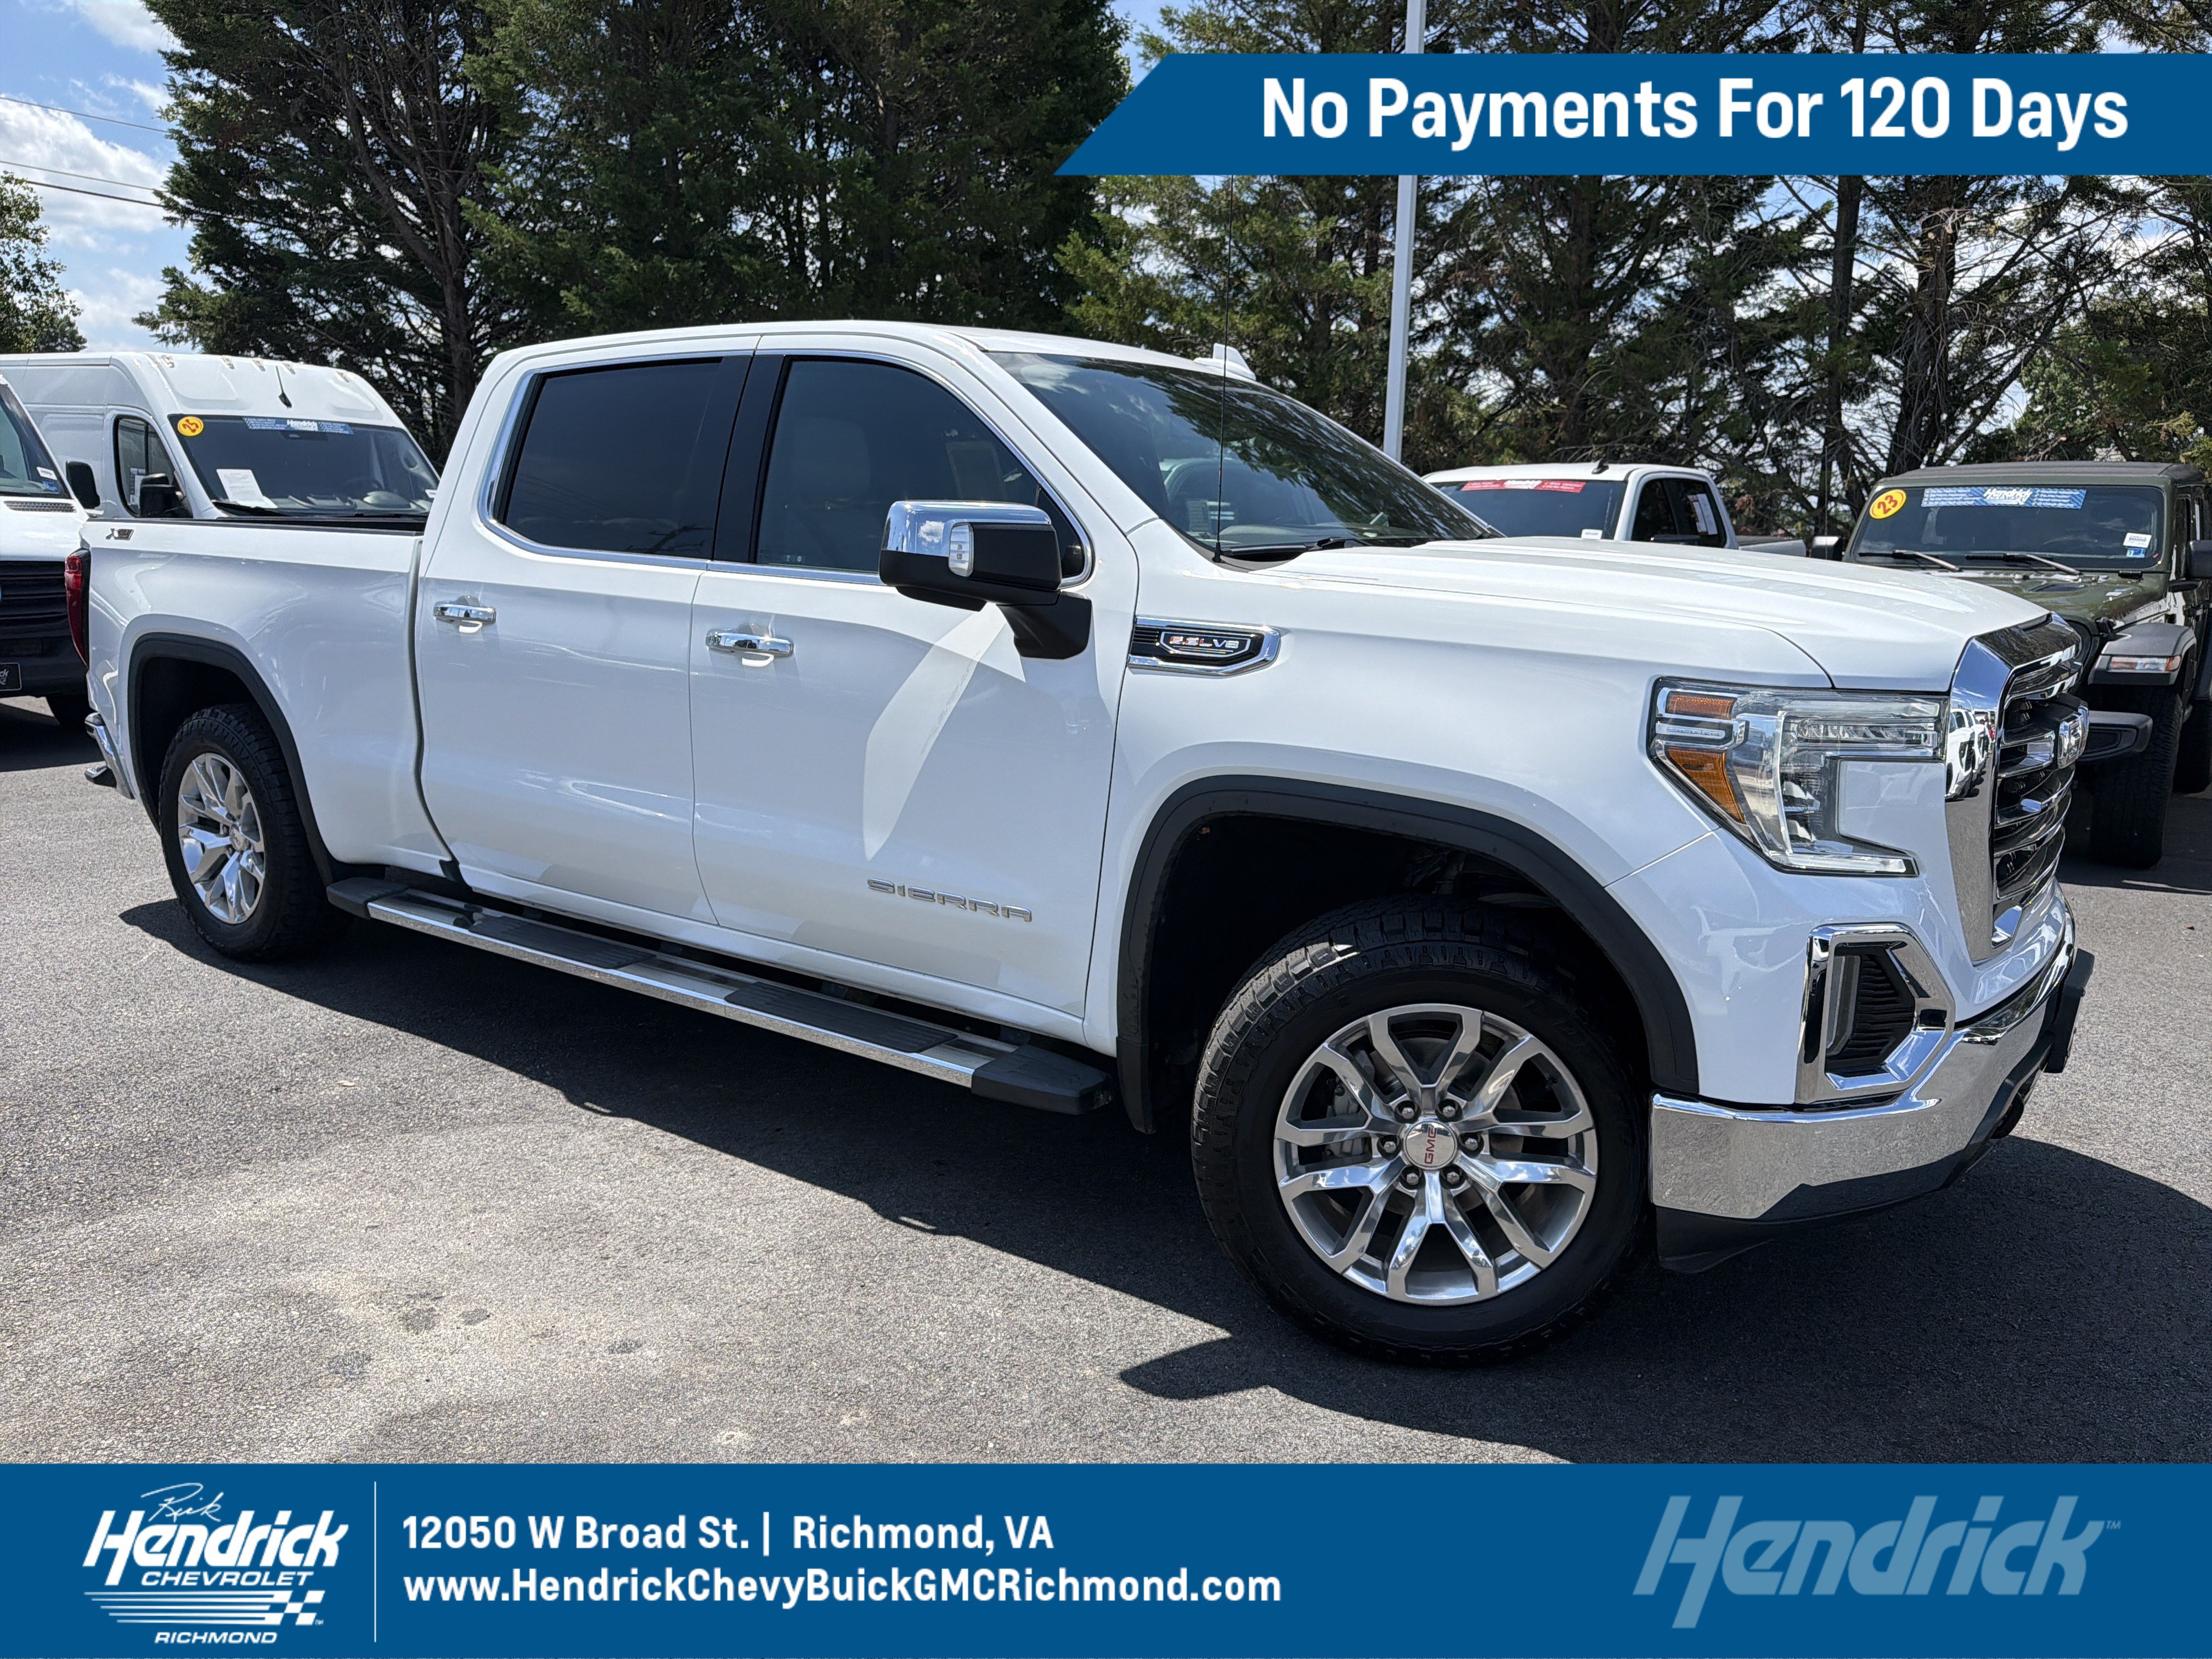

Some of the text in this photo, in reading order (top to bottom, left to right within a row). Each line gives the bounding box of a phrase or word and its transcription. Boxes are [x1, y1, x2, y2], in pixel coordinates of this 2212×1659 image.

[182, 419, 199, 433] 25
[1877, 495, 1898, 515] 23
[867, 877, 1032, 923] SIERRA
[1425, 1126, 1437, 1164] GMC
